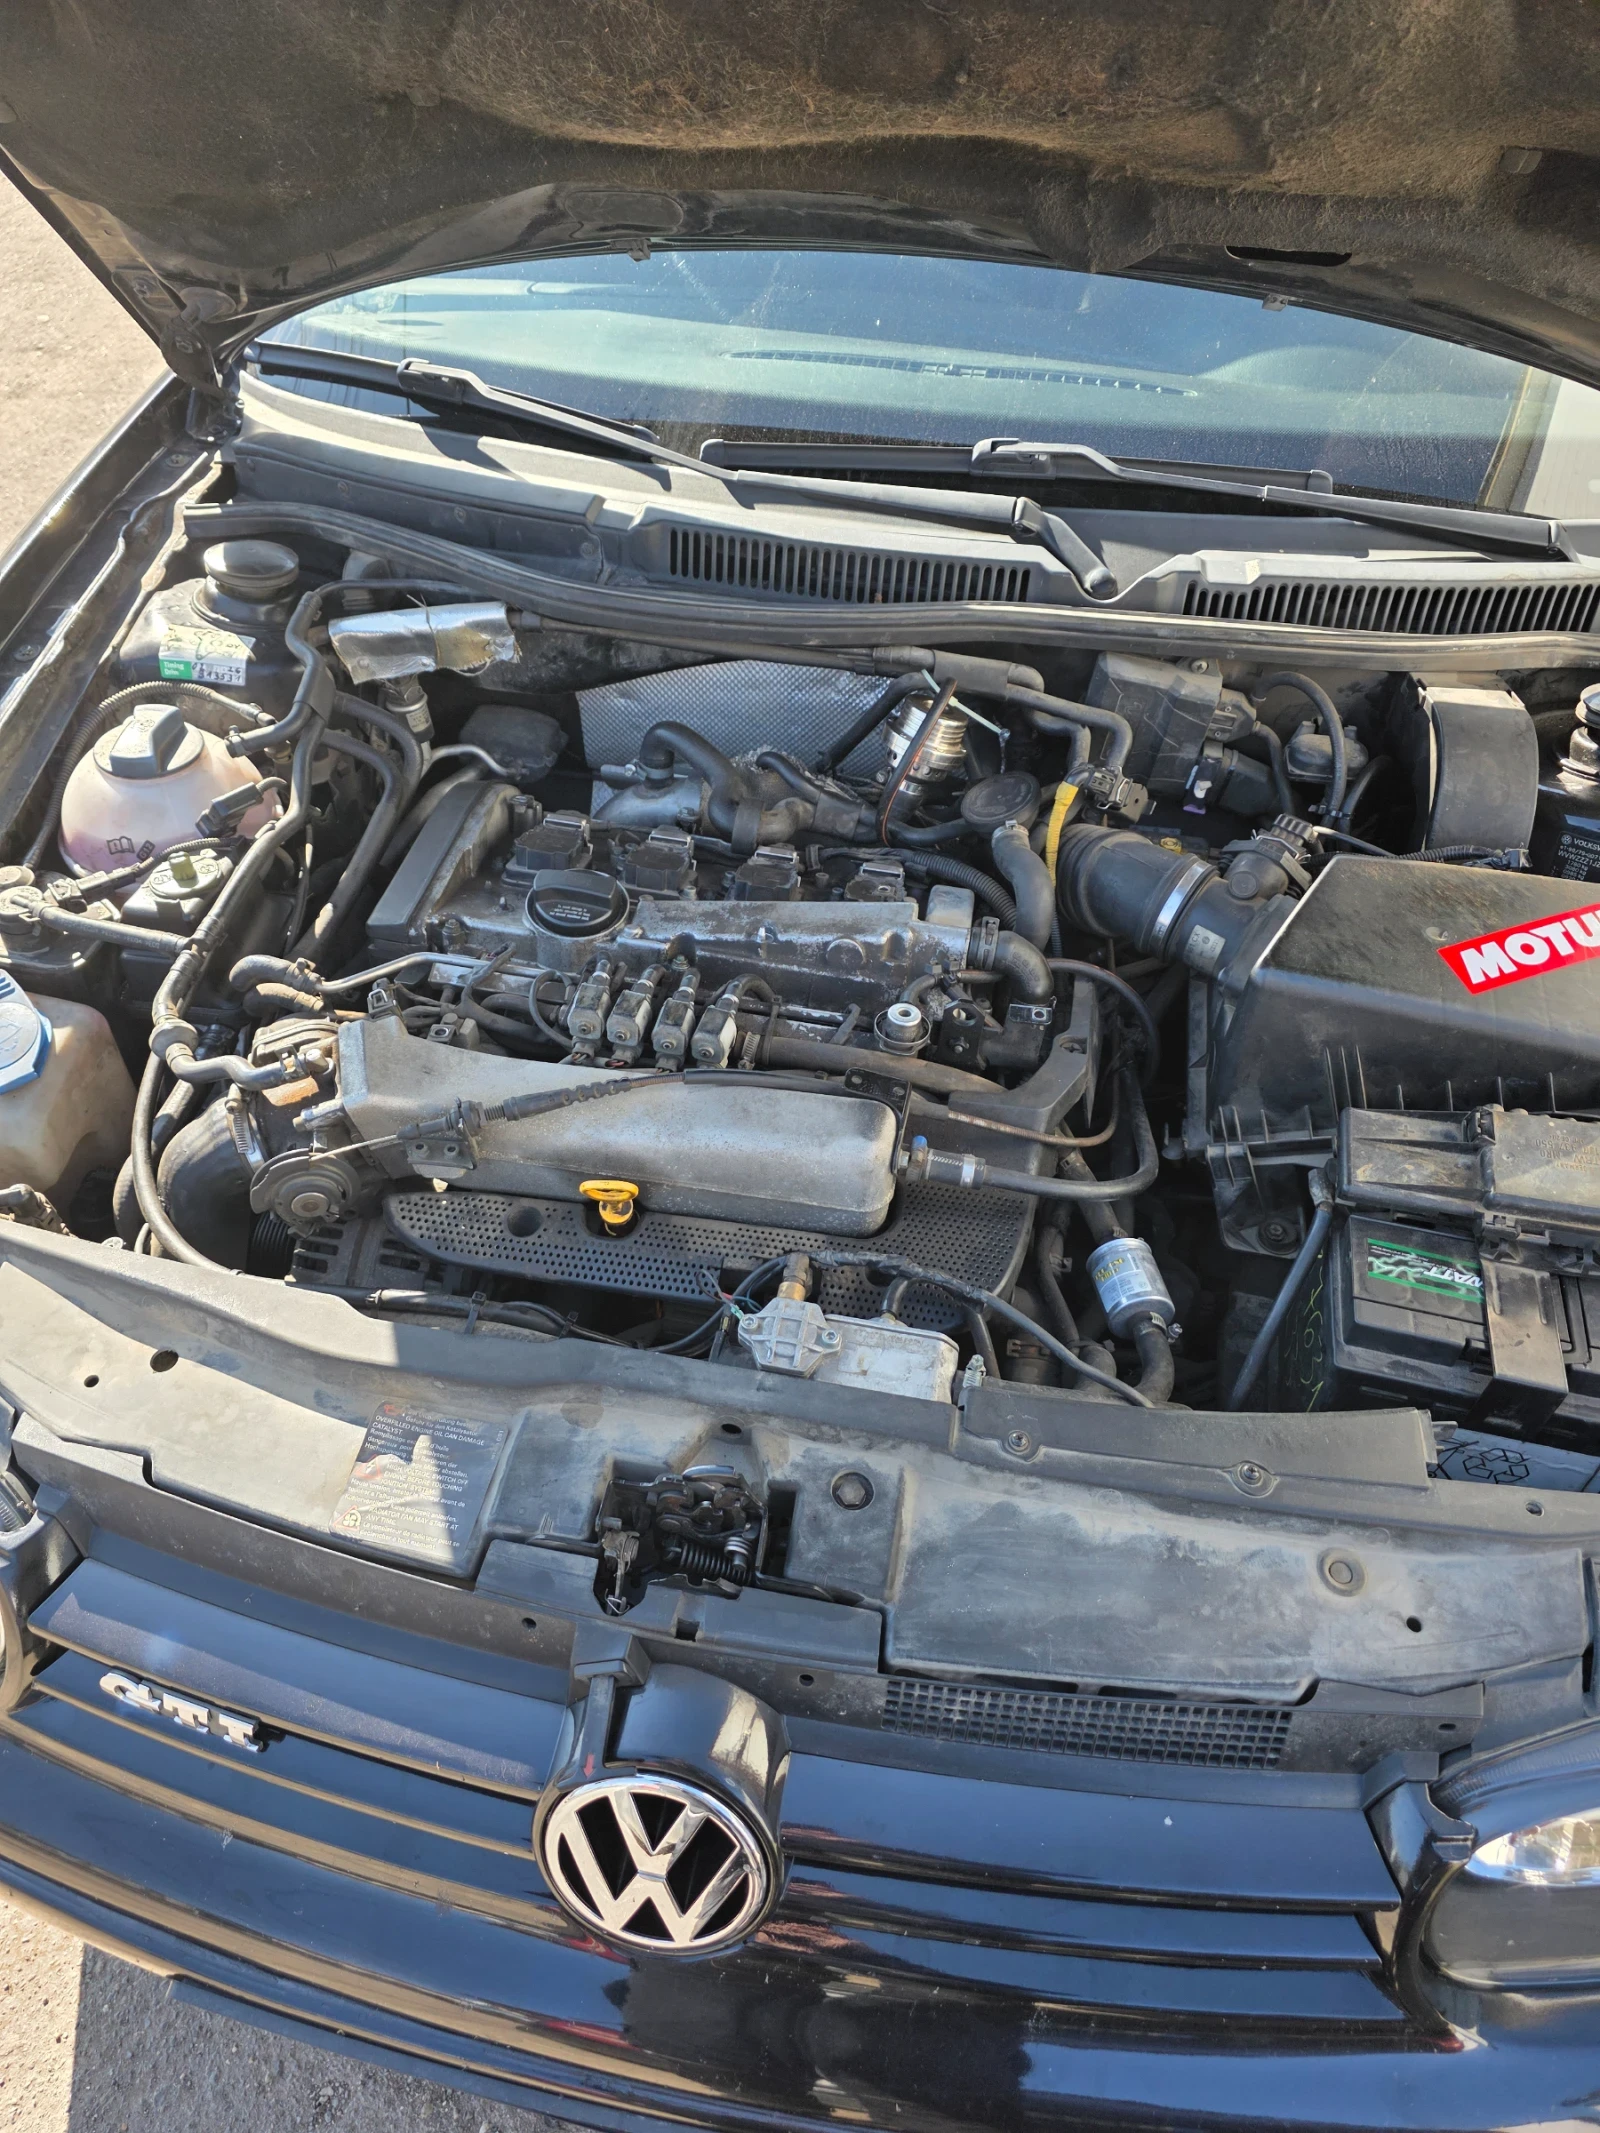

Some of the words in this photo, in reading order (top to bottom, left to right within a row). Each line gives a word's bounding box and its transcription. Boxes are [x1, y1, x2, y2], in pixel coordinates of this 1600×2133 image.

[1459, 909, 1600, 985] MOTU
[372, 1421, 404, 1435] CATALYST
[375, 1415, 411, 1430] OVERFILLED
[411, 1425, 434, 1435] ENGINE
[444, 1432, 458, 1440] CAN
